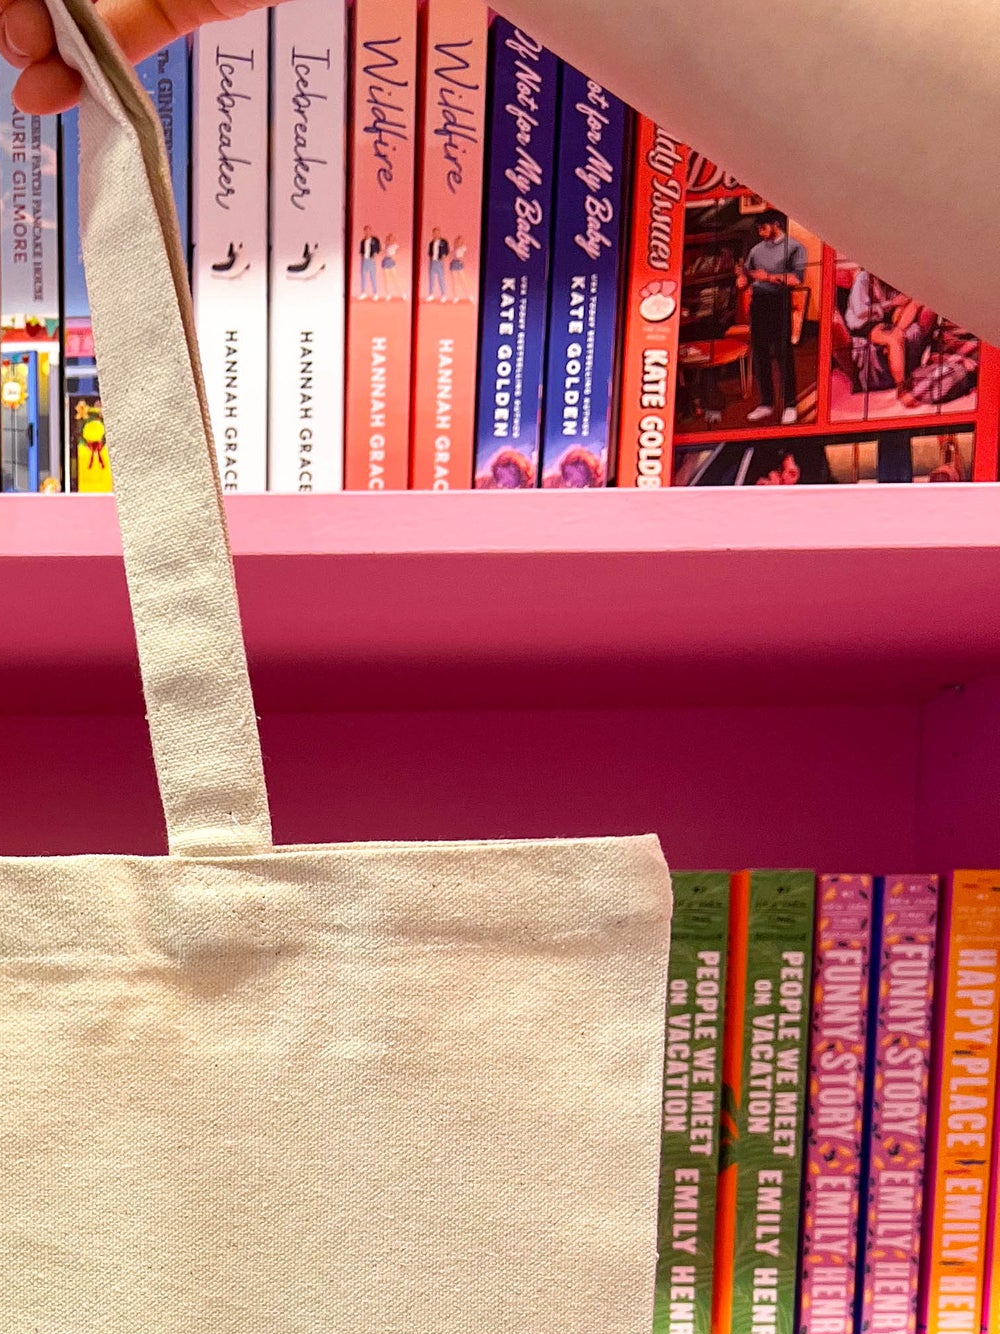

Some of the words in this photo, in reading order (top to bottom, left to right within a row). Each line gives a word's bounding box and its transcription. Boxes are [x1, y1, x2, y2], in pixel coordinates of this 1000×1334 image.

[216, 45, 255, 210] Icebreaker
[290, 45, 331, 211] Icebreaker
[362, 36, 409, 192] Wildfire
[433, 39, 480, 195] Wildfire
[505, 146, 544, 194] My
[505, 197, 544, 263] Baby
[498, 276, 516, 336] KATE
[568, 275, 586, 335] KATE
[224, 330, 239, 419] HANNAH
[299, 330, 314, 420] HANNAH
[369, 337, 387, 429] HANNAH
[436, 338, 455, 430] HANNAH
[493, 343, 513, 438] GOLDEN
[562, 342, 582, 437] GOLDEN
[224, 426, 238, 492] GRACE
[298, 427, 313, 493] GRACE
[669, 979, 689, 1006] ON
[694, 950, 721, 1041] PEOPLE
[753, 979, 773, 1006] ON
[776, 950, 805, 1041] PEOPLE
[821, 949, 862, 1041] FUNNY
[887, 943, 930, 1038] FUNNY
[953, 949, 998, 1046] HAPPY
[663, 1013, 692, 1133] VACATION
[692, 1046, 717, 1085] WE
[747, 1013, 776, 1134] VACATION
[776, 1047, 800, 1087] WE
[817, 1051, 857, 1141] STORY
[882, 1046, 924, 1136] STORY
[946, 1057, 991, 1149] PLACE
[689, 1090, 715, 1157] MEET
[773, 1091, 798, 1157] MEET
[671, 1167, 700, 1256] EMILY
[754, 1169, 783, 1258] EMILY
[813, 1175, 852, 1254] EMILY
[876, 1170, 916, 1252] EMILY
[940, 1177, 983, 1264] EMILY
